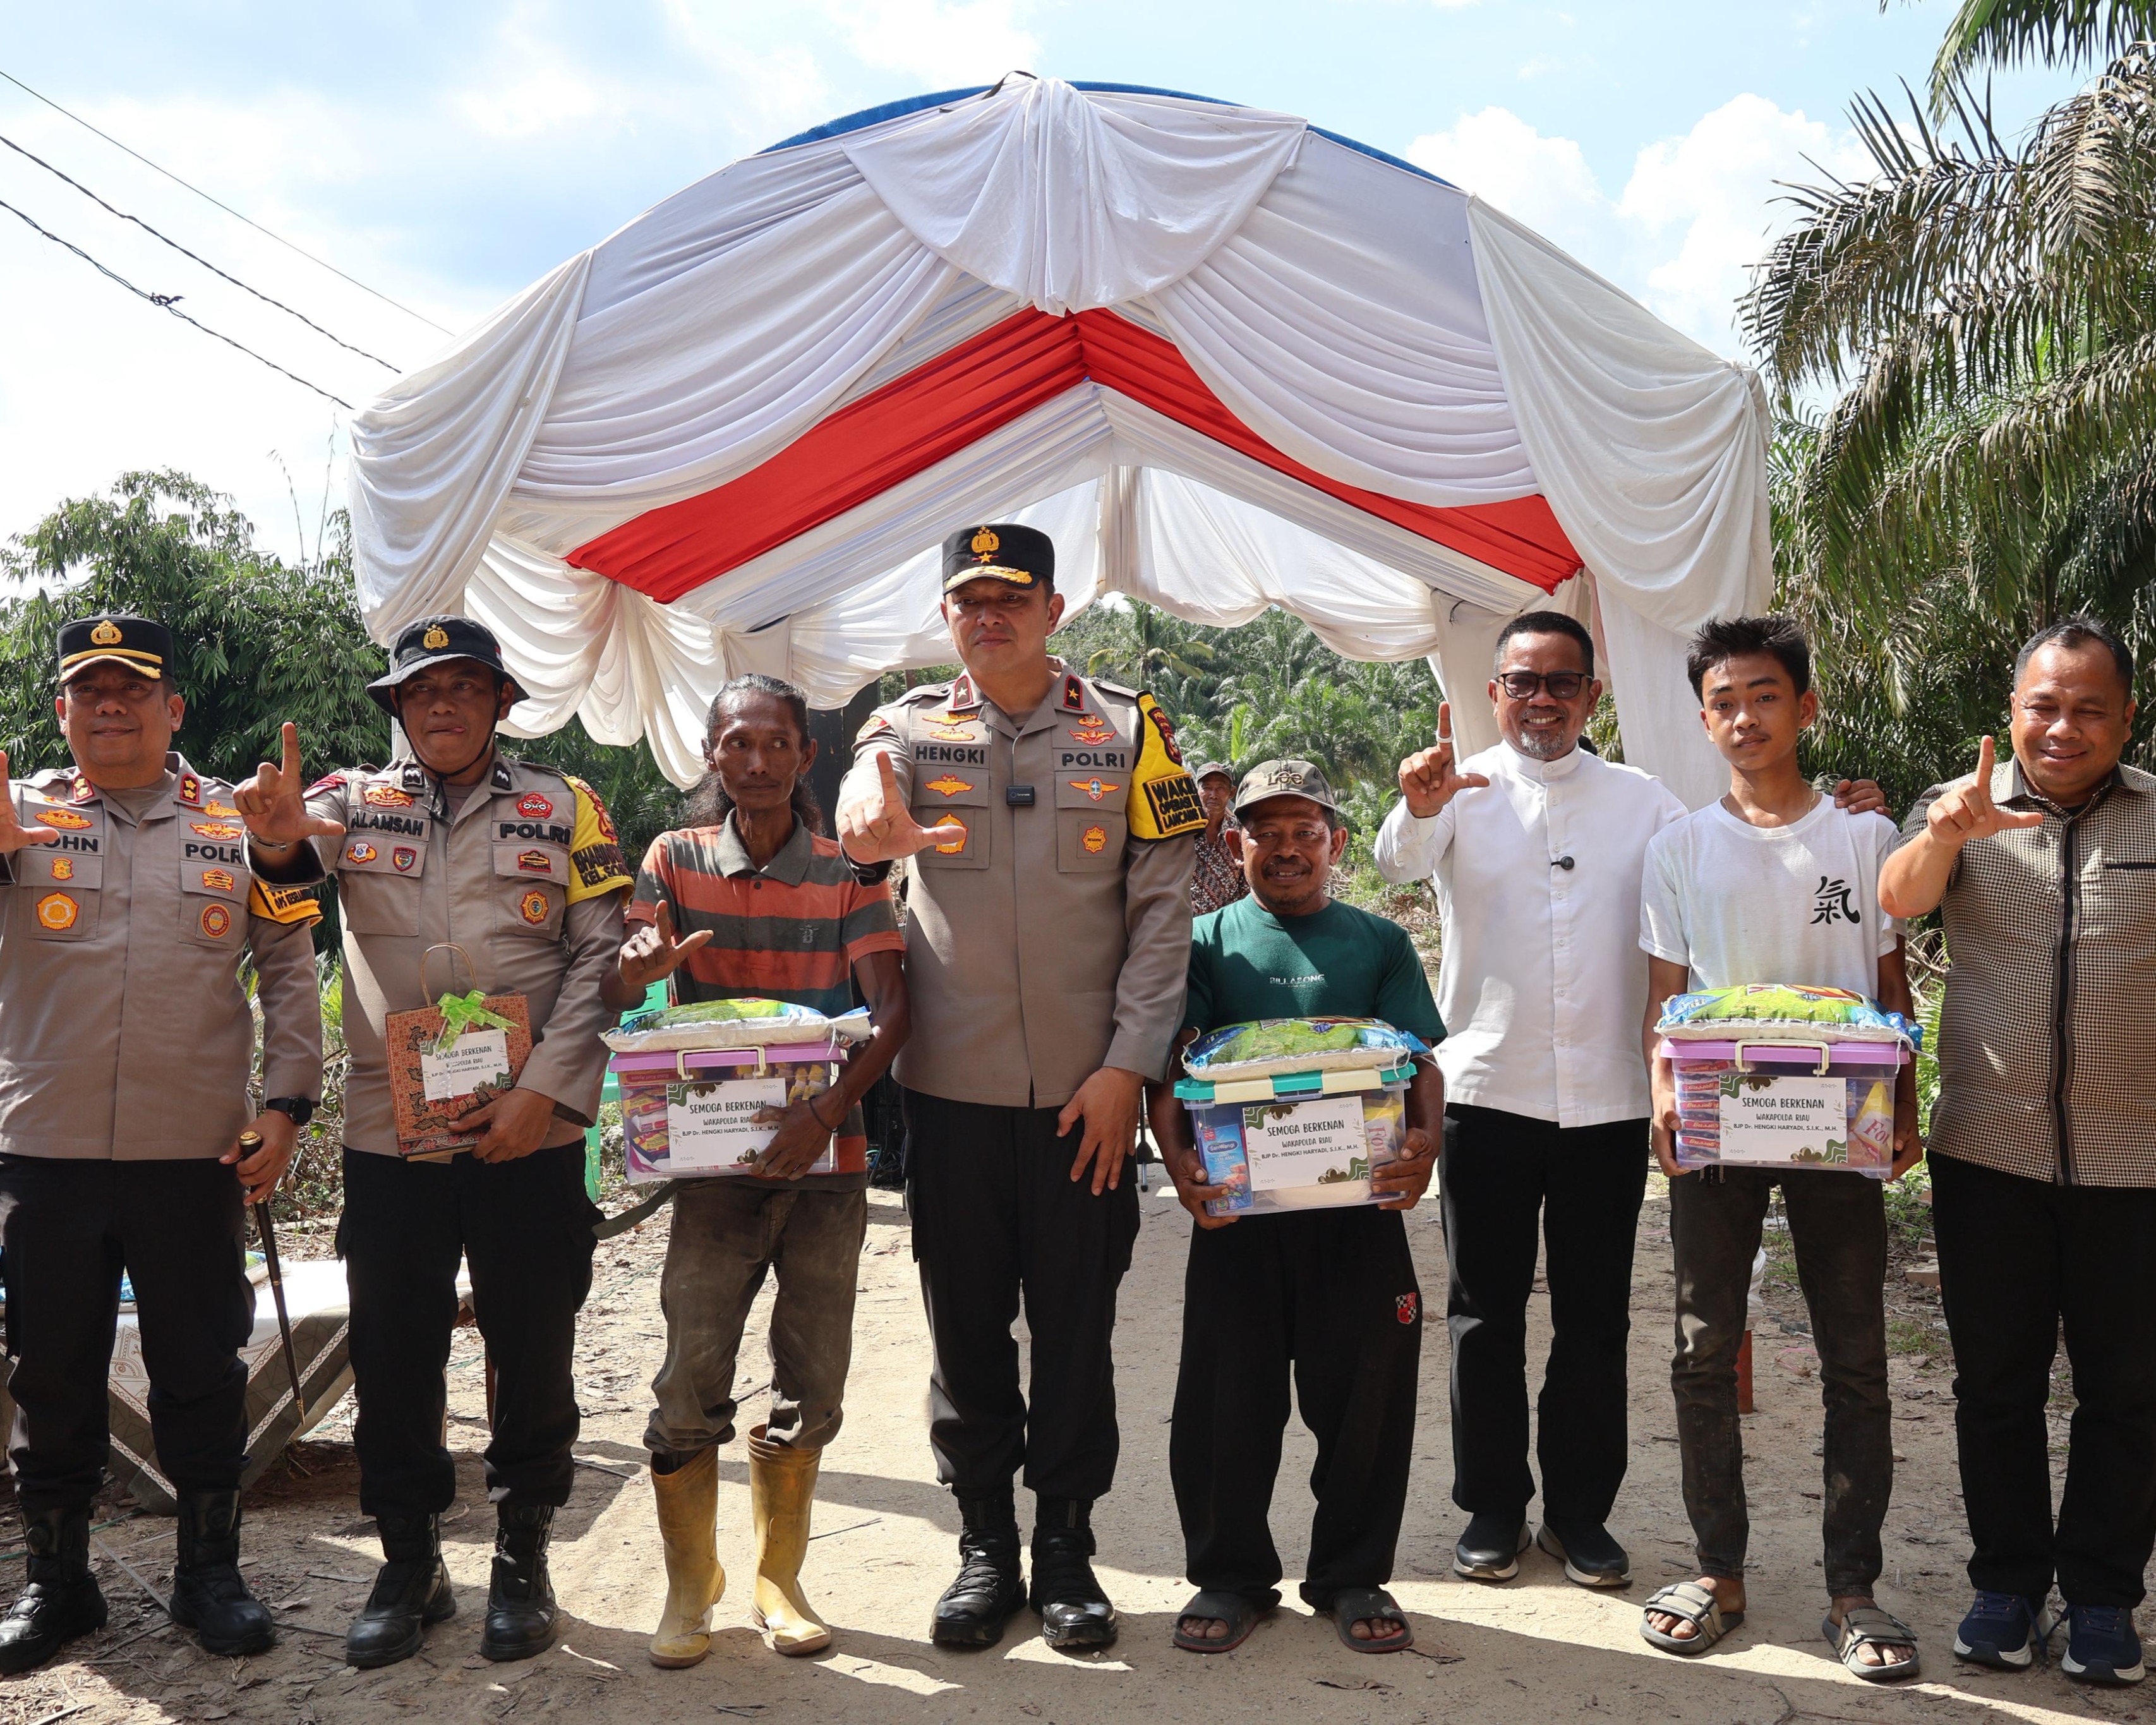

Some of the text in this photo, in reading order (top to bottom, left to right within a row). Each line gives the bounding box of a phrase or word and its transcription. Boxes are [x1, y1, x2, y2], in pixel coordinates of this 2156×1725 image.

[915, 746, 984, 764] HENGKI
[1062, 752, 1125, 768] POLRI
[1267, 771, 1304, 786] Lee
[351, 812, 424, 836] ALAMSAH
[500, 823, 571, 845] POLRI
[185, 843, 243, 864] POLR
[1810, 875, 1860, 924] 氣
[462, 1045, 492, 1057] BERKENAN
[689, 1100, 767, 1114] SEMOGA BERKENAN
[1742, 1097, 1824, 1109] SEMOGA BERKENAN
[703, 1117, 738, 1126] WAKAPOLDA
[1267, 1119, 1344, 1137] SEMOGA BERKENAN
[1282, 1138, 1316, 1148] WAKAPOLDA
